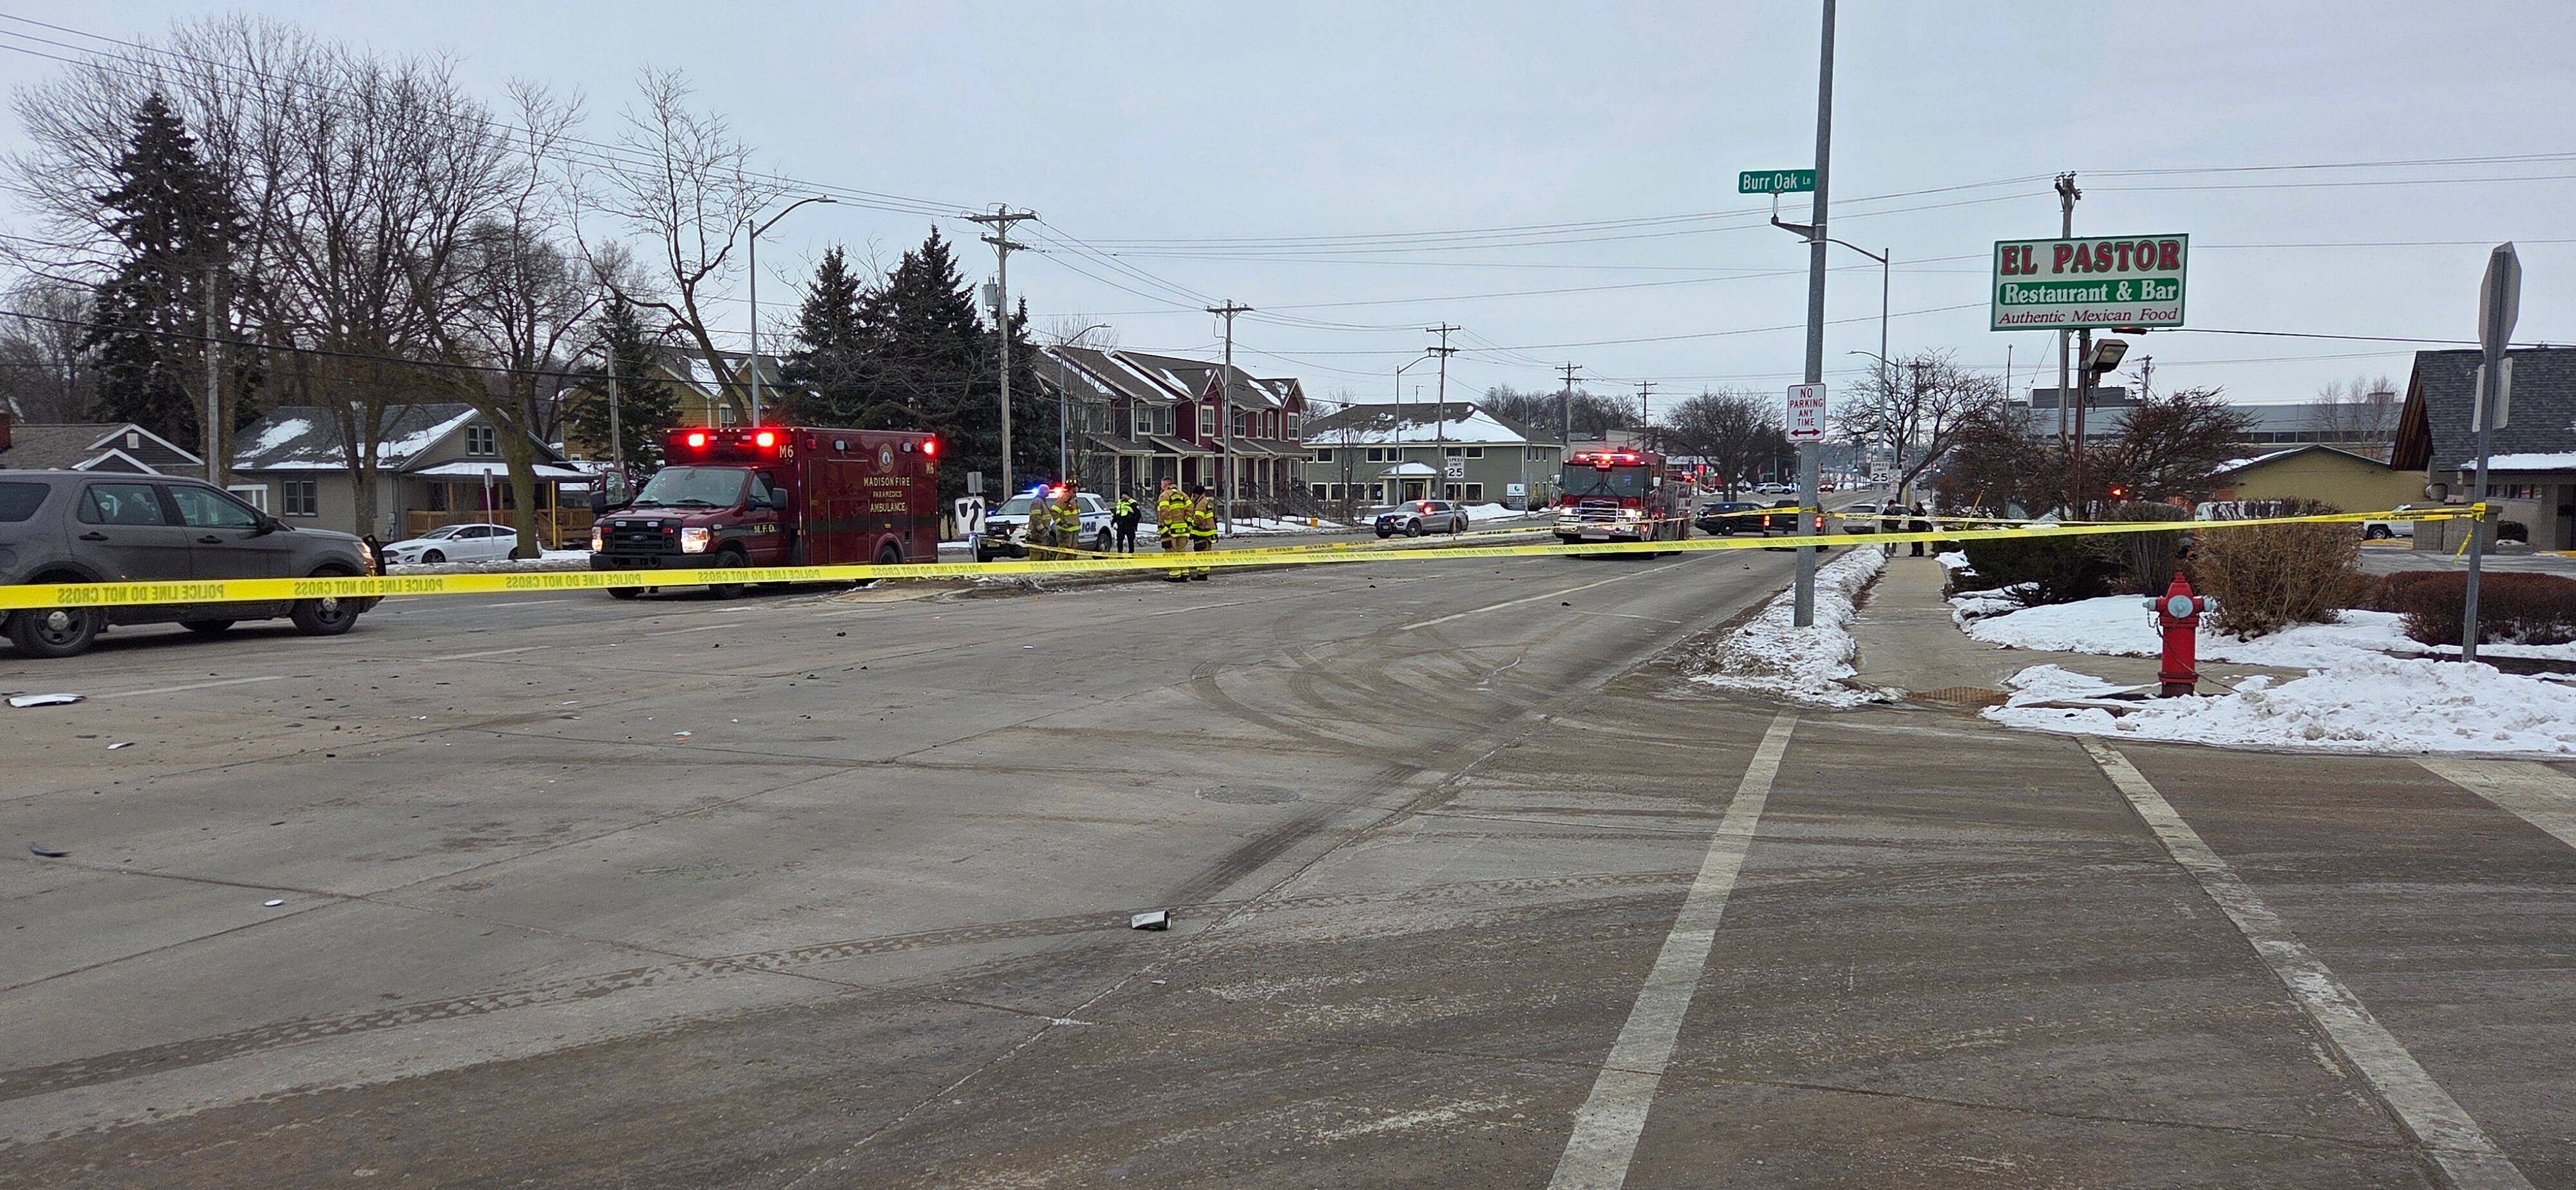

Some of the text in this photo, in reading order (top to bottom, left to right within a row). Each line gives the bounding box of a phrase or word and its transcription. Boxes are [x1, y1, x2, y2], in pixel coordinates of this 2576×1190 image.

[1743, 173, 1811, 190] Burr Oak Ln
[2000, 240, 2181, 276] EL PASTOR
[2004, 279, 2177, 304] Restaurant & Bar
[1998, 307, 2179, 324] Authentic Mexican Food
[1800, 388, 1813, 398] NO
[1790, 399, 1823, 409] PARKING
[1798, 409, 1814, 417] ANY
[1797, 418, 1815, 426] TIME
[779, 444, 793, 458] M6
[925, 462, 934, 474] M6
[1448, 468, 1463, 477] 25
[864, 477, 911, 487] MADISON FIRE
[1872, 473, 1888, 482] 25
[870, 502, 906, 513] AMBULANCE
